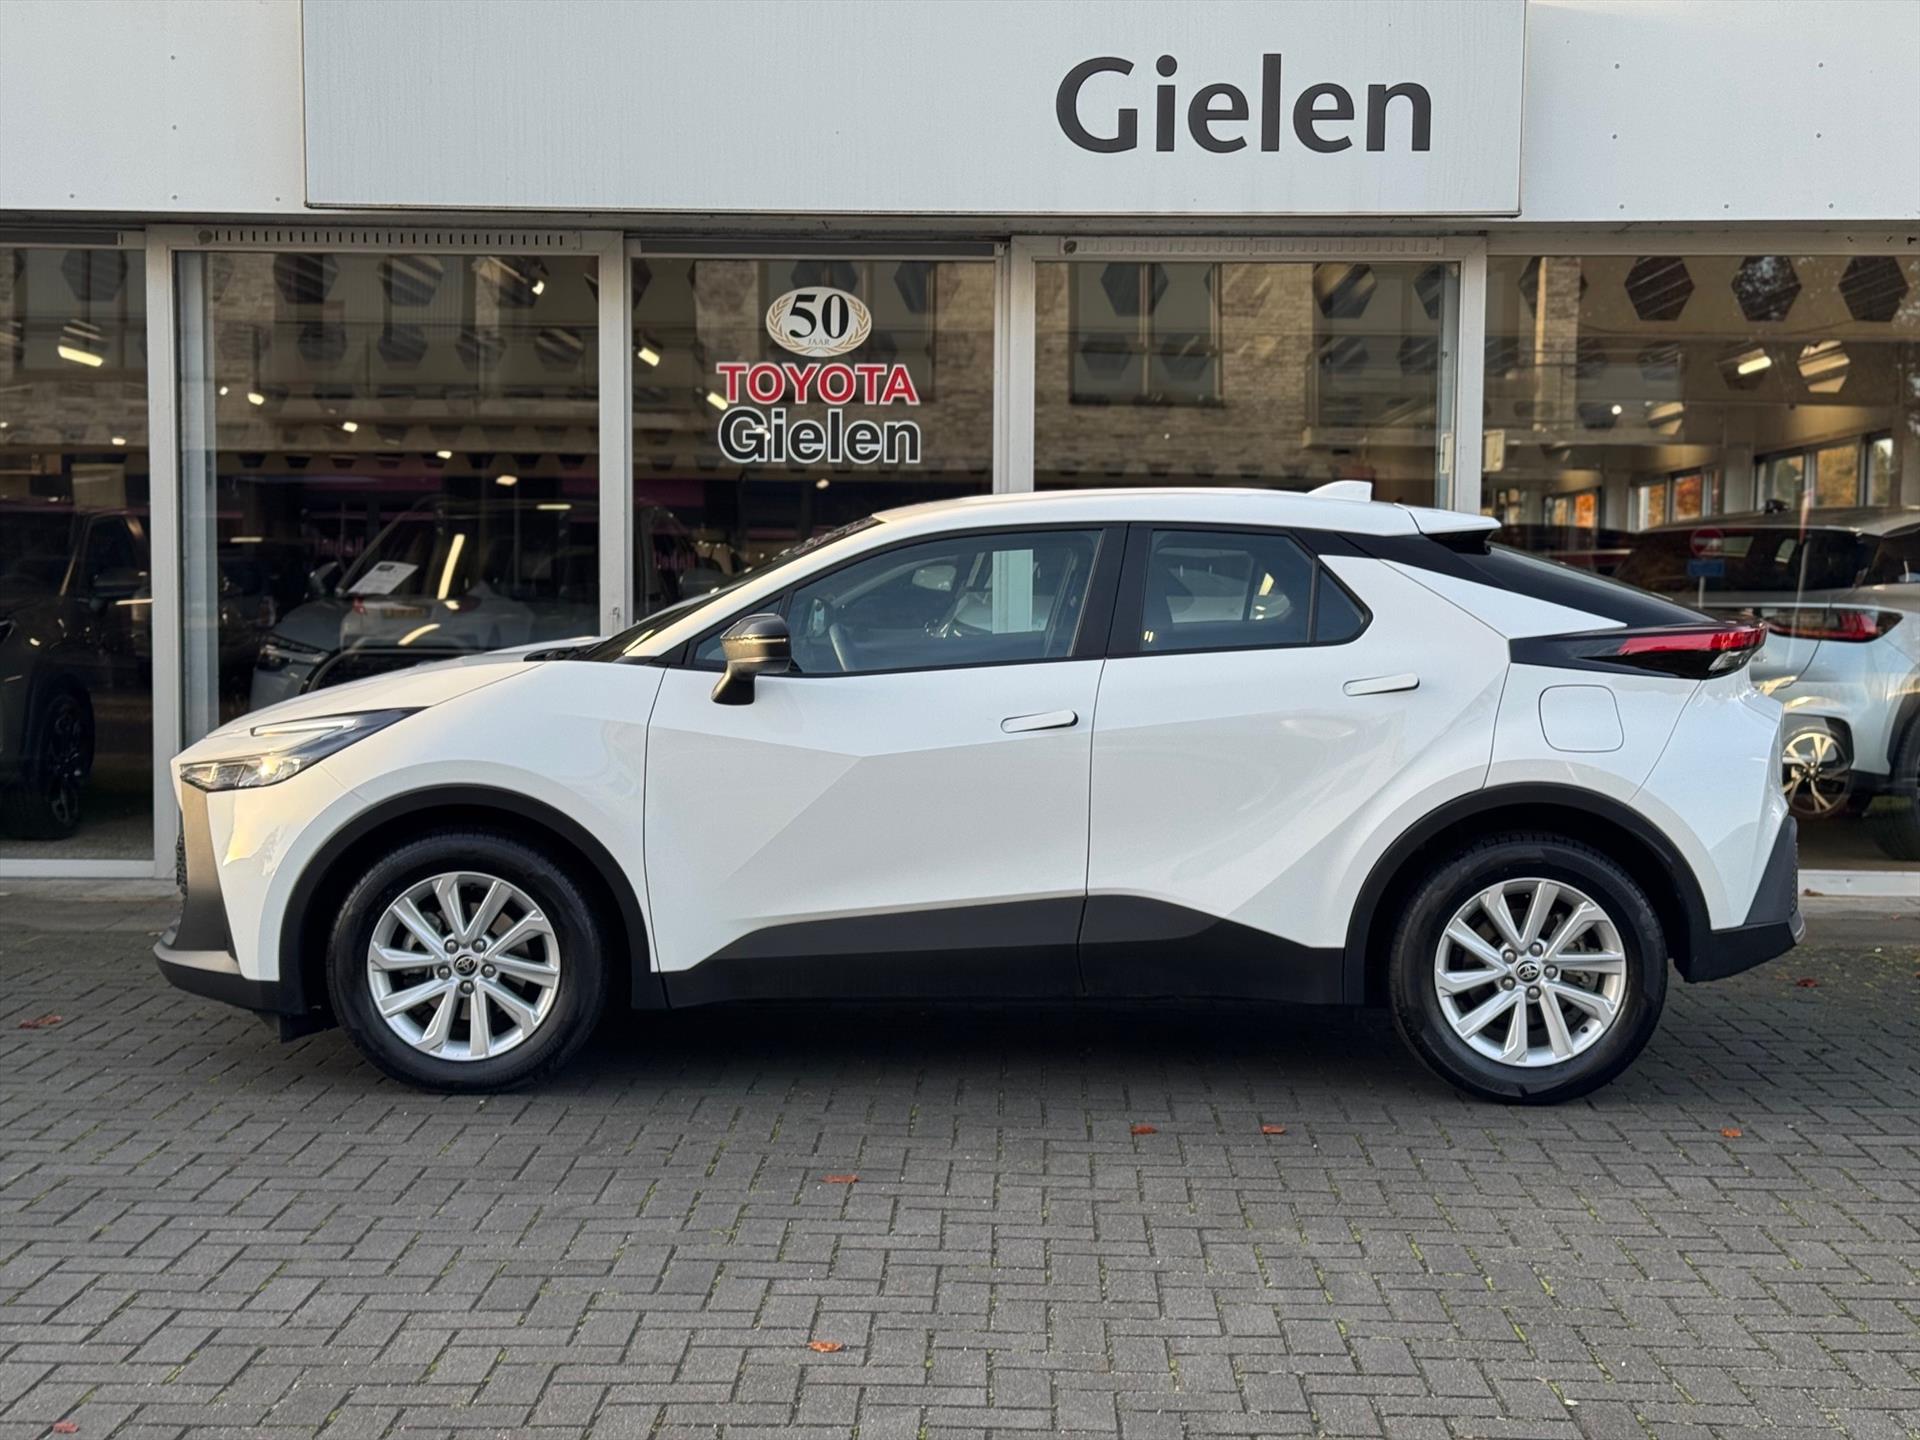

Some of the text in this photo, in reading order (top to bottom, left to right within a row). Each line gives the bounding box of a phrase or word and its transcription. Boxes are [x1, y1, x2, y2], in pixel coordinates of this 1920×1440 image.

[1056, 53, 1432, 153] Gielen
[789, 294, 850, 339] 50
[807, 338, 831, 346] JAAR
[716, 362, 920, 405] TOYOTA
[718, 406, 921, 465] Gielen
